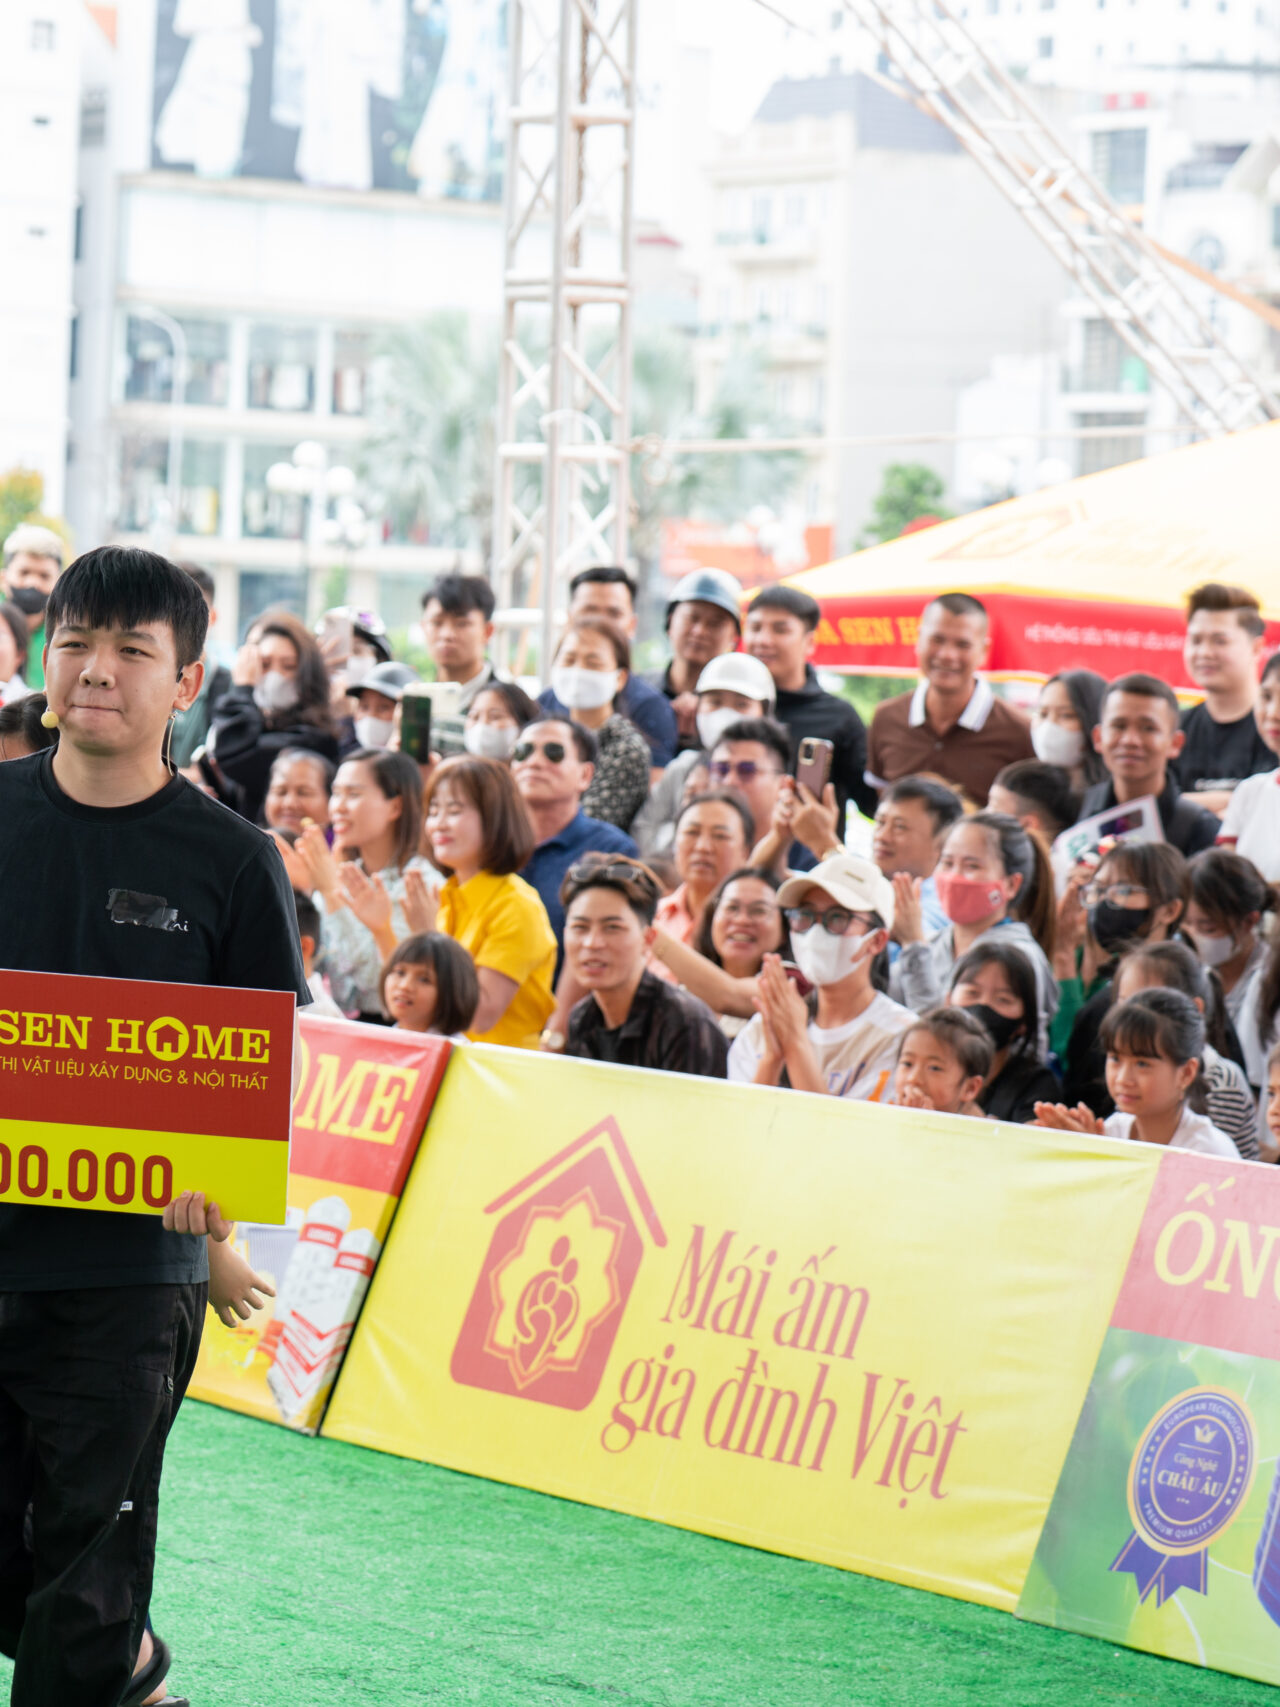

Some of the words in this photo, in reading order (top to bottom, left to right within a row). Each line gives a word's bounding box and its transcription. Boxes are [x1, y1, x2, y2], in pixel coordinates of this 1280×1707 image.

[106, 1016, 270, 1063] HOME
[22, 1056, 53, 1075] VẬT
[55, 1056, 85, 1078] LIỆU
[89, 1059, 120, 1080] XÂY
[124, 1065, 172, 1086] DỰNG
[177, 1069, 189, 1085] &
[193, 1068, 225, 1089] NỘI
[230, 1069, 269, 1091] THẤT
[660, 1224, 779, 1340] Mái
[772, 1245, 871, 1360] ấm
[601, 1343, 698, 1454] gia
[703, 1347, 838, 1472] đình
[851, 1371, 969, 1509] Việt
[1156, 1469, 1200, 1492] CHÂU
[1199, 1475, 1223, 1498] ÂU
